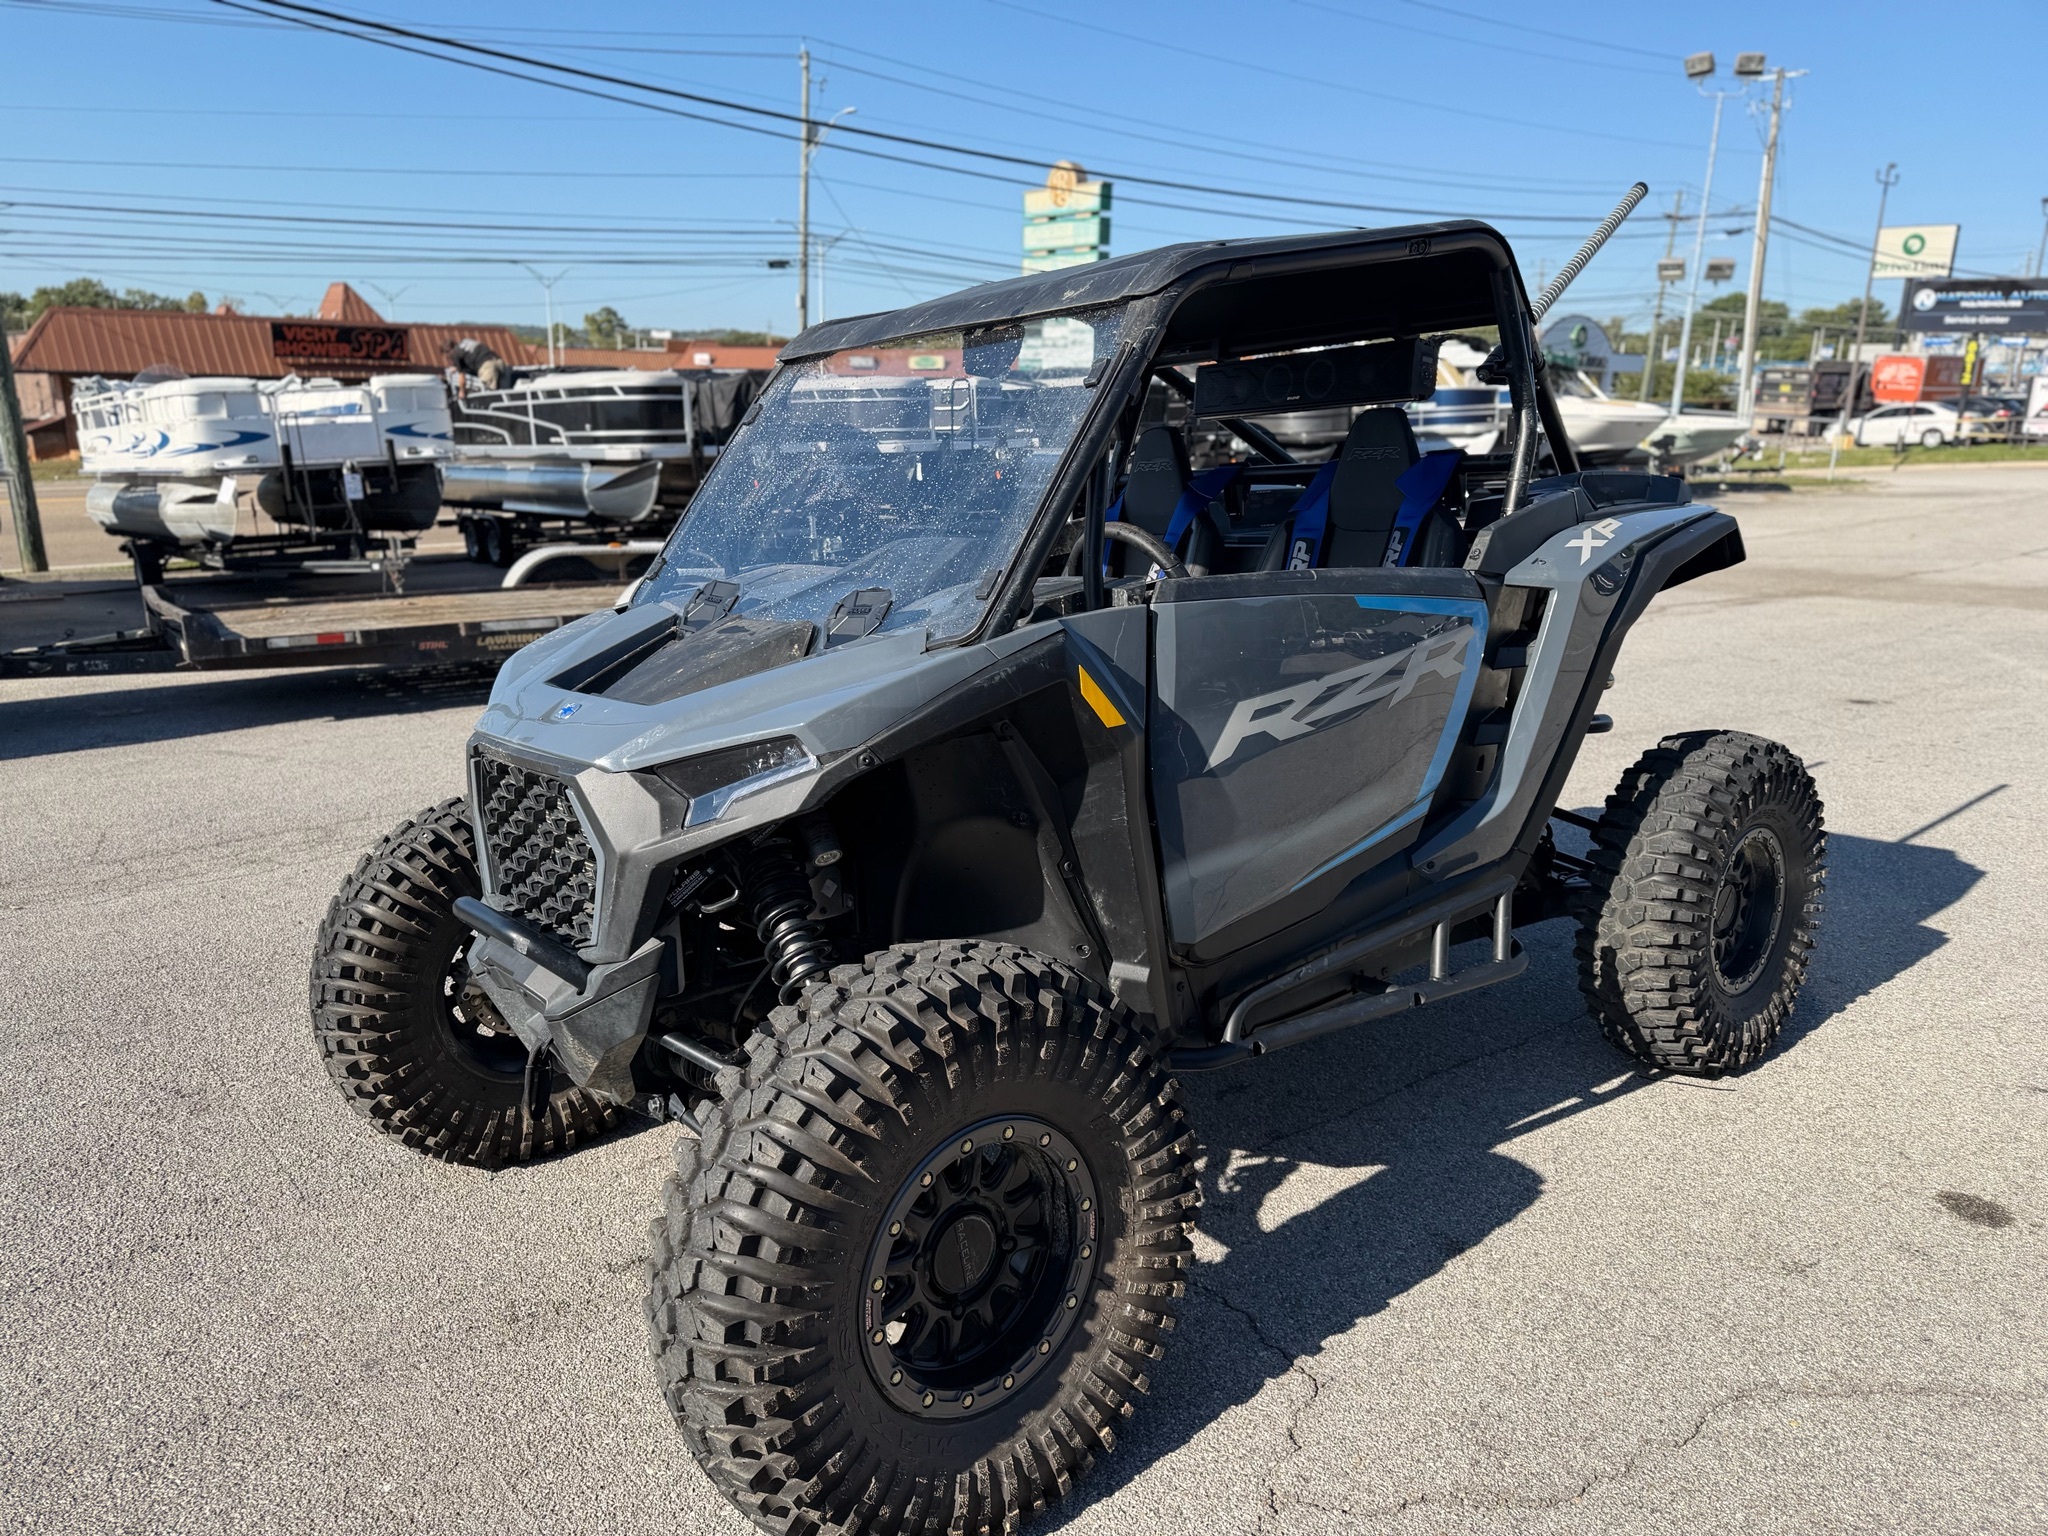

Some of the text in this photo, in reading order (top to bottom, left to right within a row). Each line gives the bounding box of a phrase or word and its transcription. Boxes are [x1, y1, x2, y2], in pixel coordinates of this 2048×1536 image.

[274, 328, 410, 359] SHOWER SPA
[282, 325, 338, 342] VICHY
[1565, 517, 1623, 566] XP
[418, 640, 448, 651] STIHL
[477, 633, 546, 646] LAWRIMO
[1202, 623, 1476, 774] RZR
[666, 869, 701, 901] POLARIS
[956, 1222, 974, 1284] RACELINE
